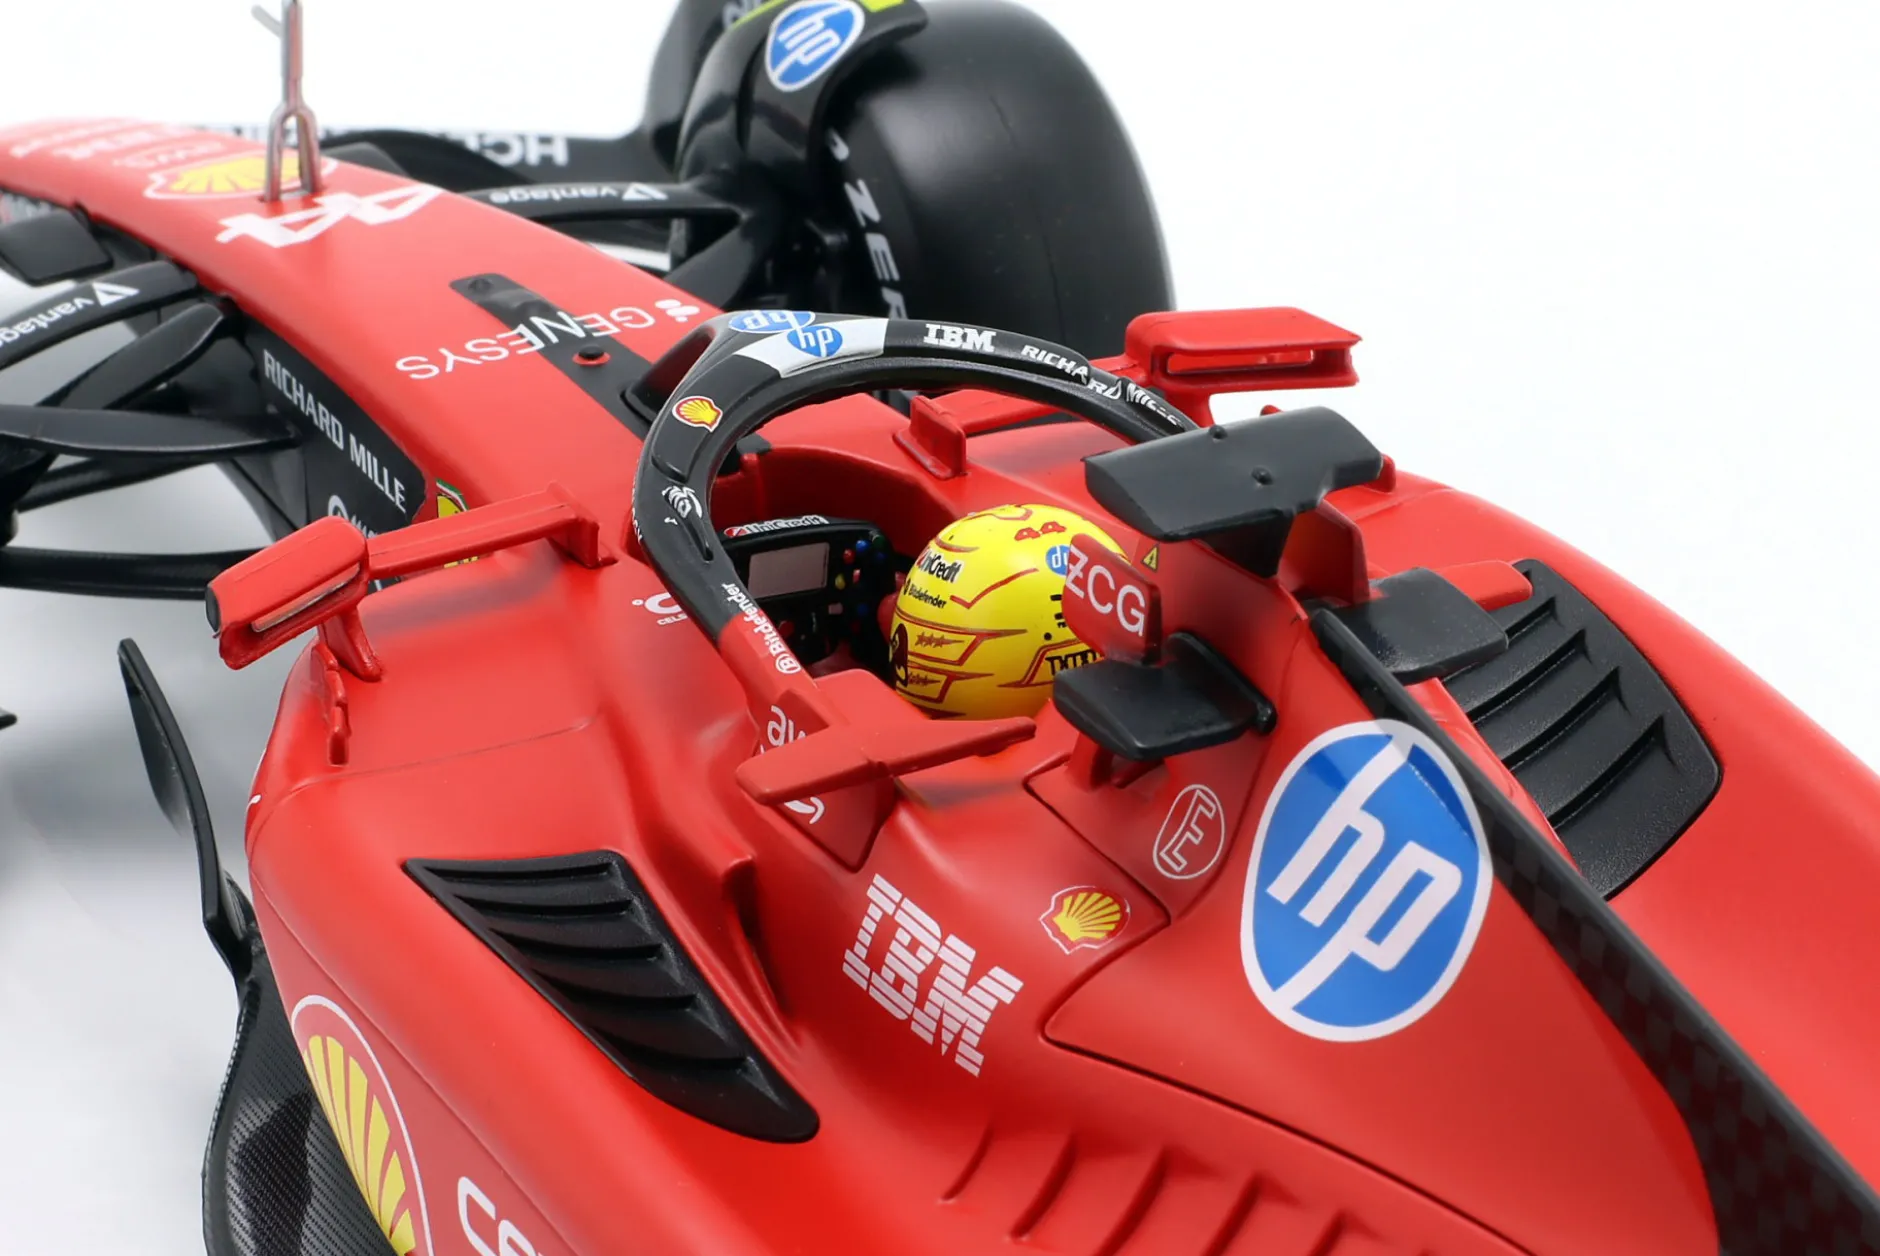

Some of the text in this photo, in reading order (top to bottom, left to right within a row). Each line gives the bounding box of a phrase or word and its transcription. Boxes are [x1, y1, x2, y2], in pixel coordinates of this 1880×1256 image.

[770, 4, 852, 80] hp
[215, 183, 443, 248] 44
[489, 186, 619, 203] vantage
[844, 179, 909, 320] ZER
[396, 307, 656, 379] GENESYS
[797, 326, 835, 358] hp
[923, 323, 997, 353] IBM
[1021, 345, 1122, 399] RICHARD
[264, 349, 406, 513] RICHARD MILLE
[744, 515, 829, 534] UniCredit
[721, 583, 787, 656] Bitdefender
[1066, 544, 1146, 637] ZCG
[1265, 733, 1463, 1010] hp
[842, 873, 1024, 1077] IBM
